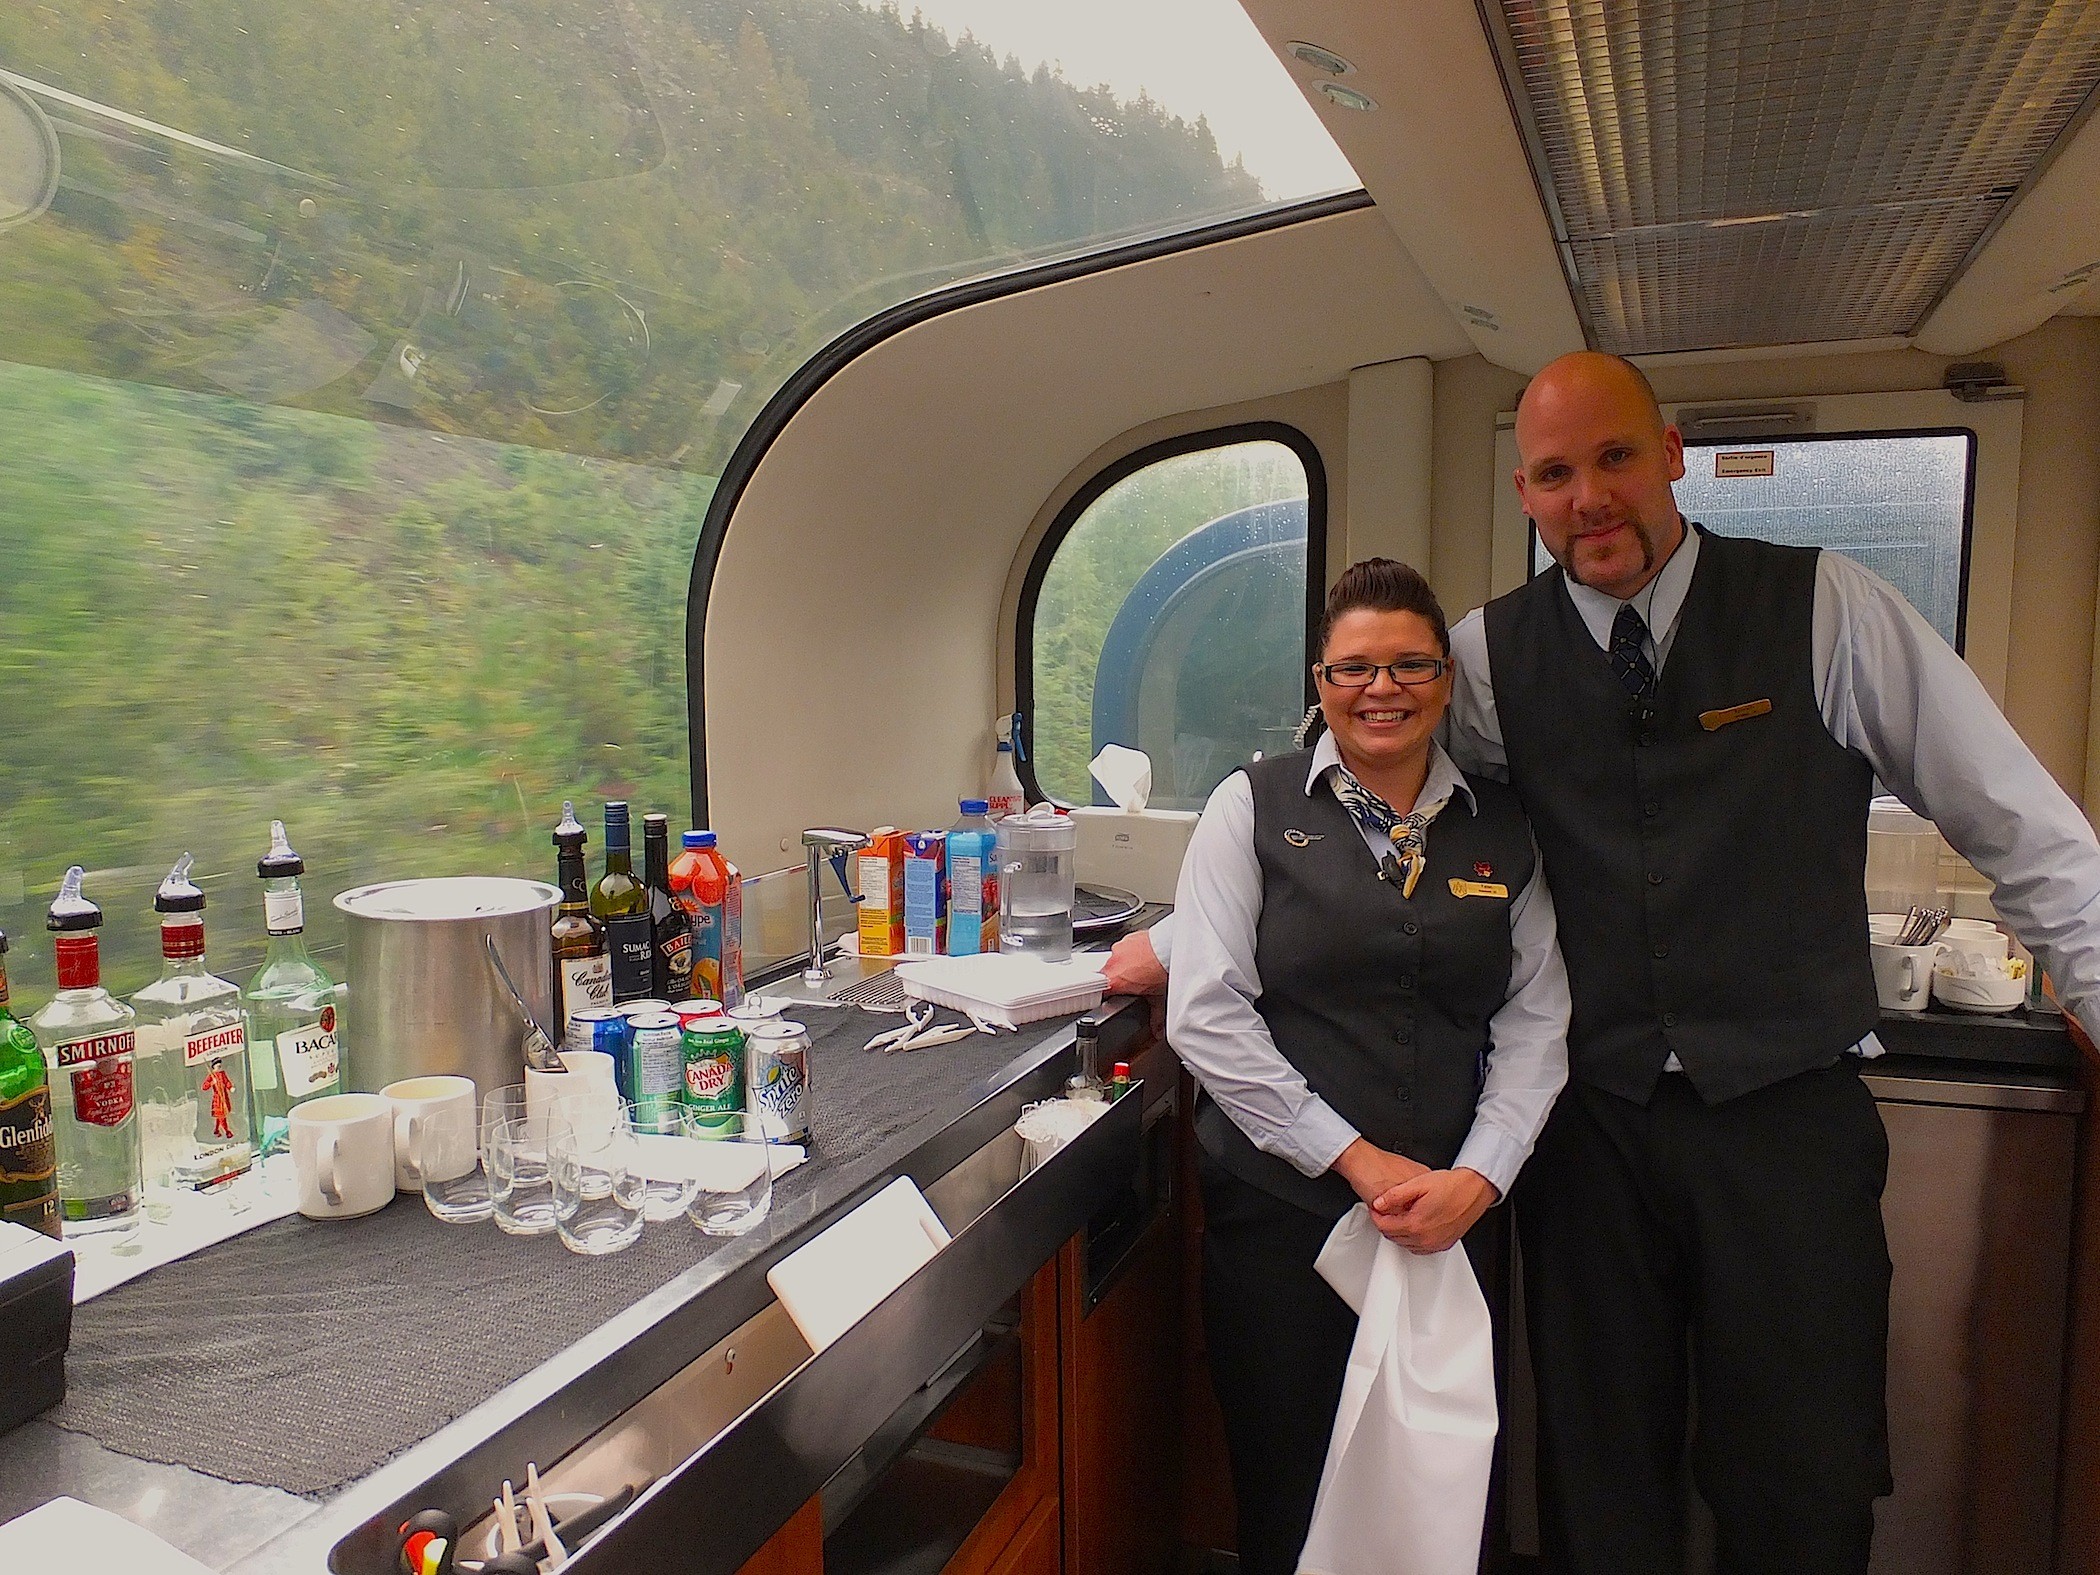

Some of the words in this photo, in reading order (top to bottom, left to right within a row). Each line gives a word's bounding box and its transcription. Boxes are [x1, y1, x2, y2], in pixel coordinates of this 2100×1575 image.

[187, 1028, 243, 1059] BEEFEATER
[295, 1032, 337, 1054] BACA
[686, 1062, 734, 1085] CANADA
[699, 1074, 724, 1091] DRY
[758, 1066, 798, 1116] Sprite
[95, 1096, 124, 1107] VODKA
[689, 1103, 716, 1112] GINGER
[717, 1102, 732, 1111] ALE
[777, 1083, 803, 1119] zero
[194, 1147, 224, 1160] LONDON
[43, 1200, 56, 1216] 12
